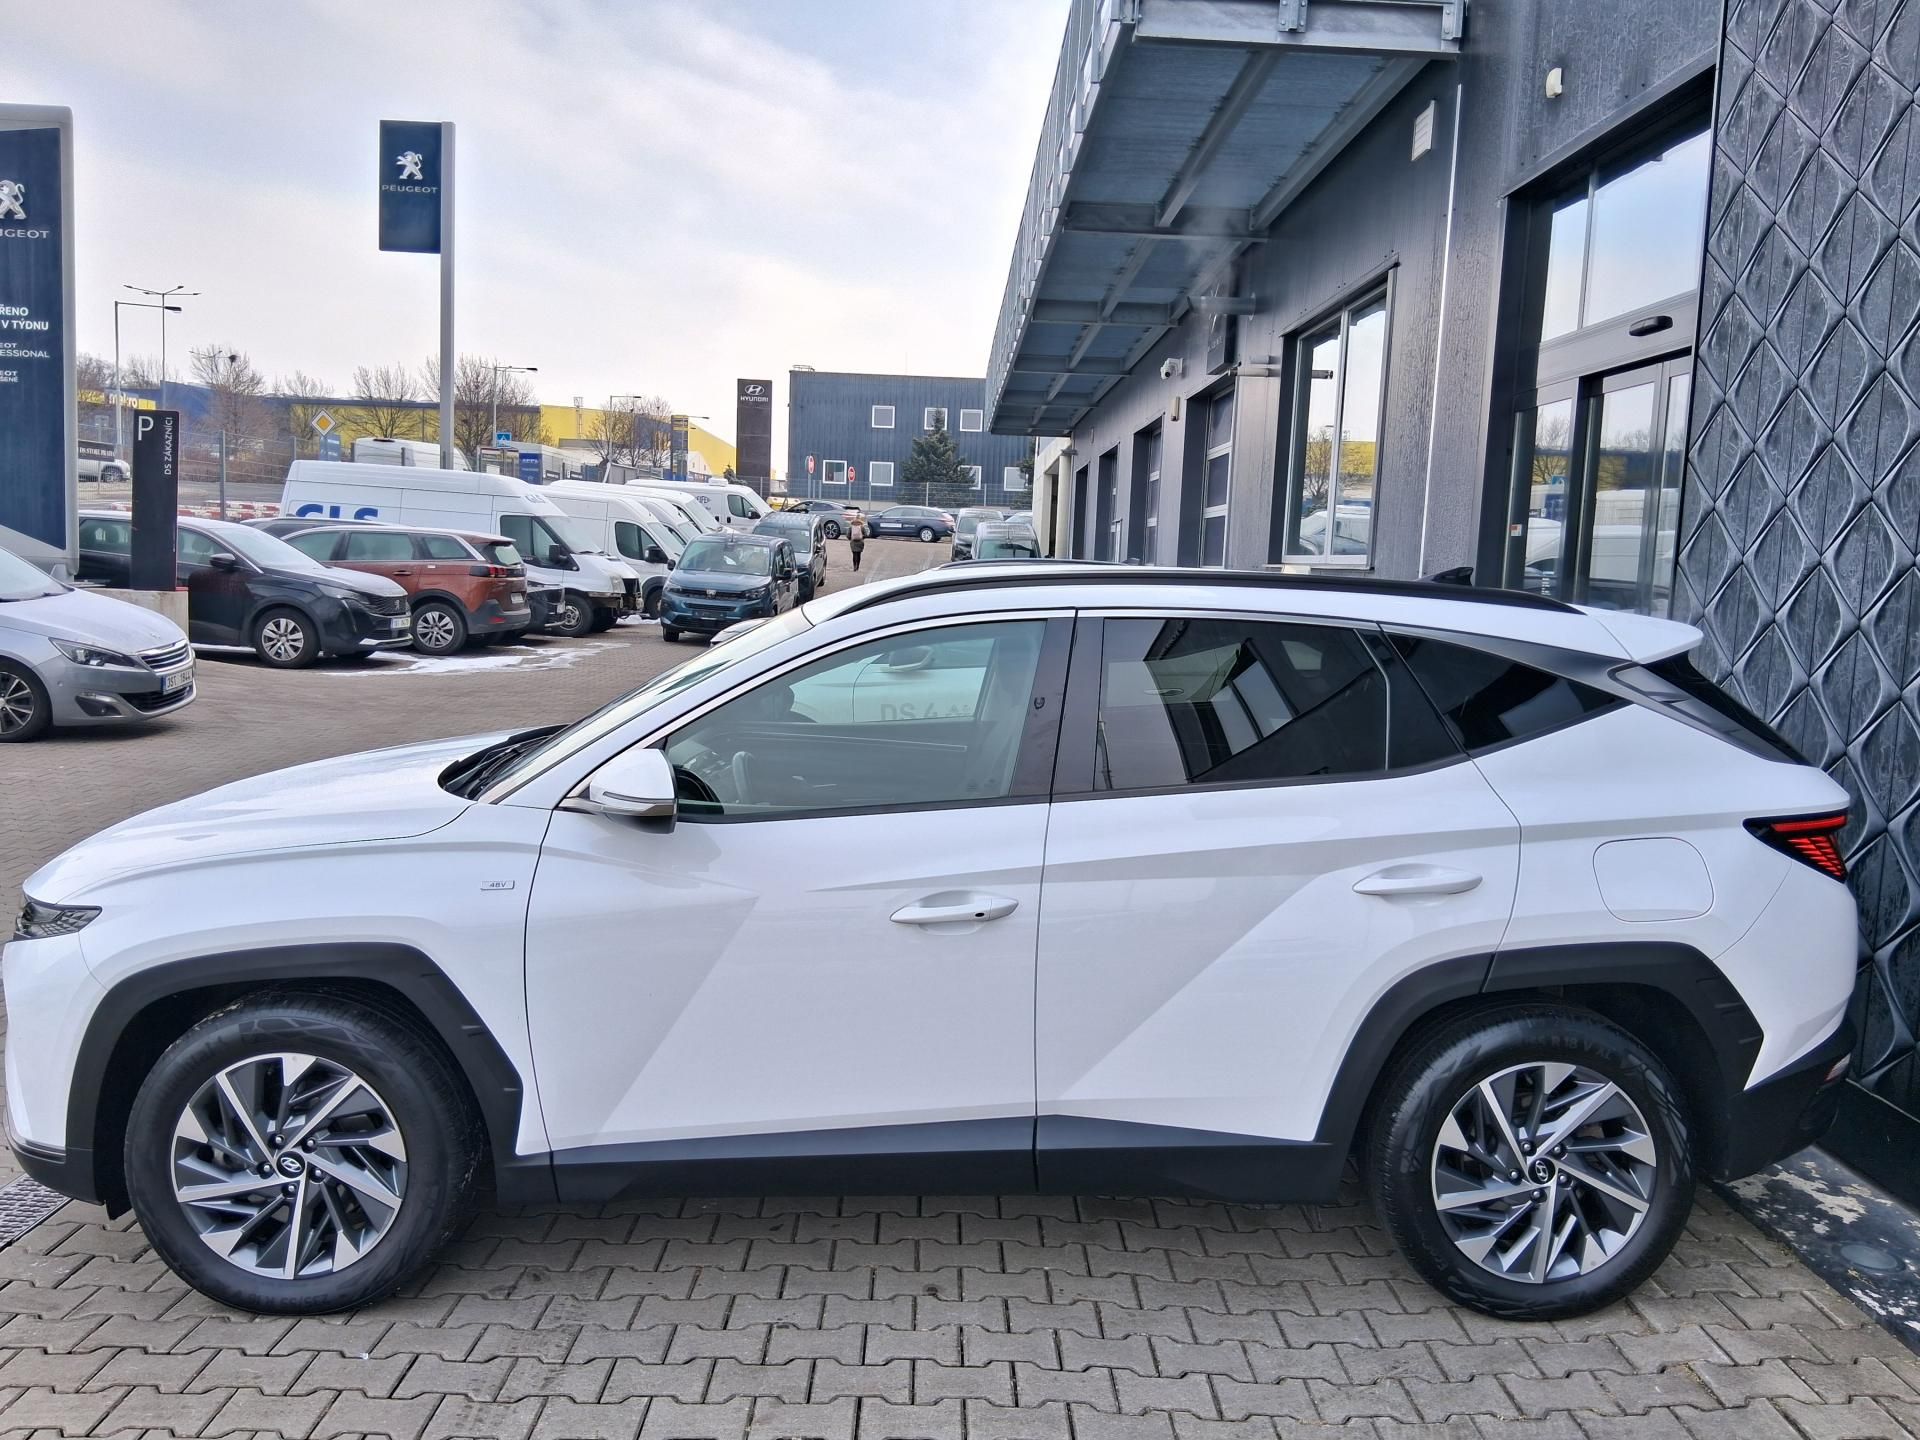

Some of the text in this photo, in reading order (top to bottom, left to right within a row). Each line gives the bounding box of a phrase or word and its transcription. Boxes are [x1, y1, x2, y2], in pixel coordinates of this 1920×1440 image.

[382, 184, 439, 194] PEUGEOT
[1, 317, 49, 331] V TÝDNU
[138, 415, 154, 441] P
[163, 417, 173, 475] DS ZÁKAZNÍCI
